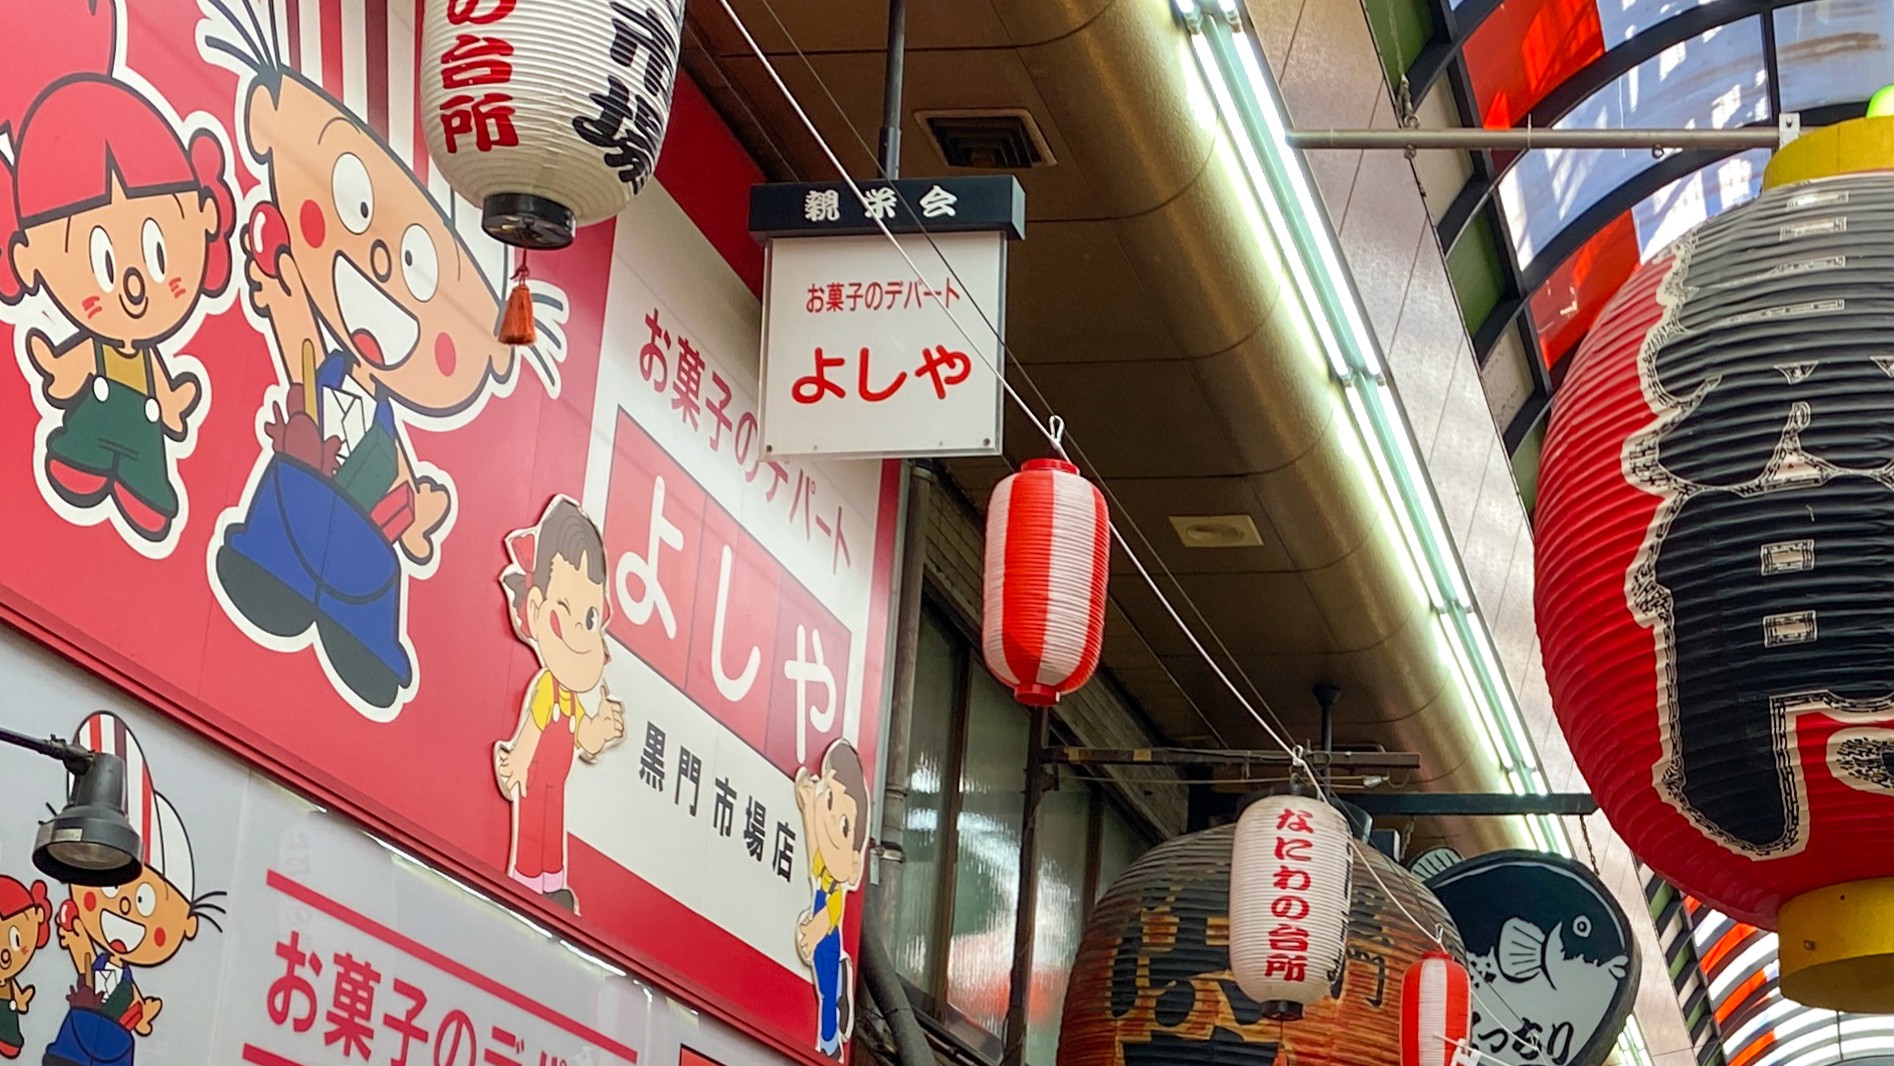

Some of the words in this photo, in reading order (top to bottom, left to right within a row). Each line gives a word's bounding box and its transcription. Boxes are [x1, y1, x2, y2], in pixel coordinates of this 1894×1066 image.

[804, 184, 958, 222] 親栄会
[806, 276, 961, 313] お菓子のデパート
[791, 343, 973, 404] よしや
[614, 474, 839, 766] よしや
[638, 720, 797, 884] 黒門市場店
[1264, 807, 1315, 983] なにわの台所
[1472, 1012, 1575, 1066] っちり
